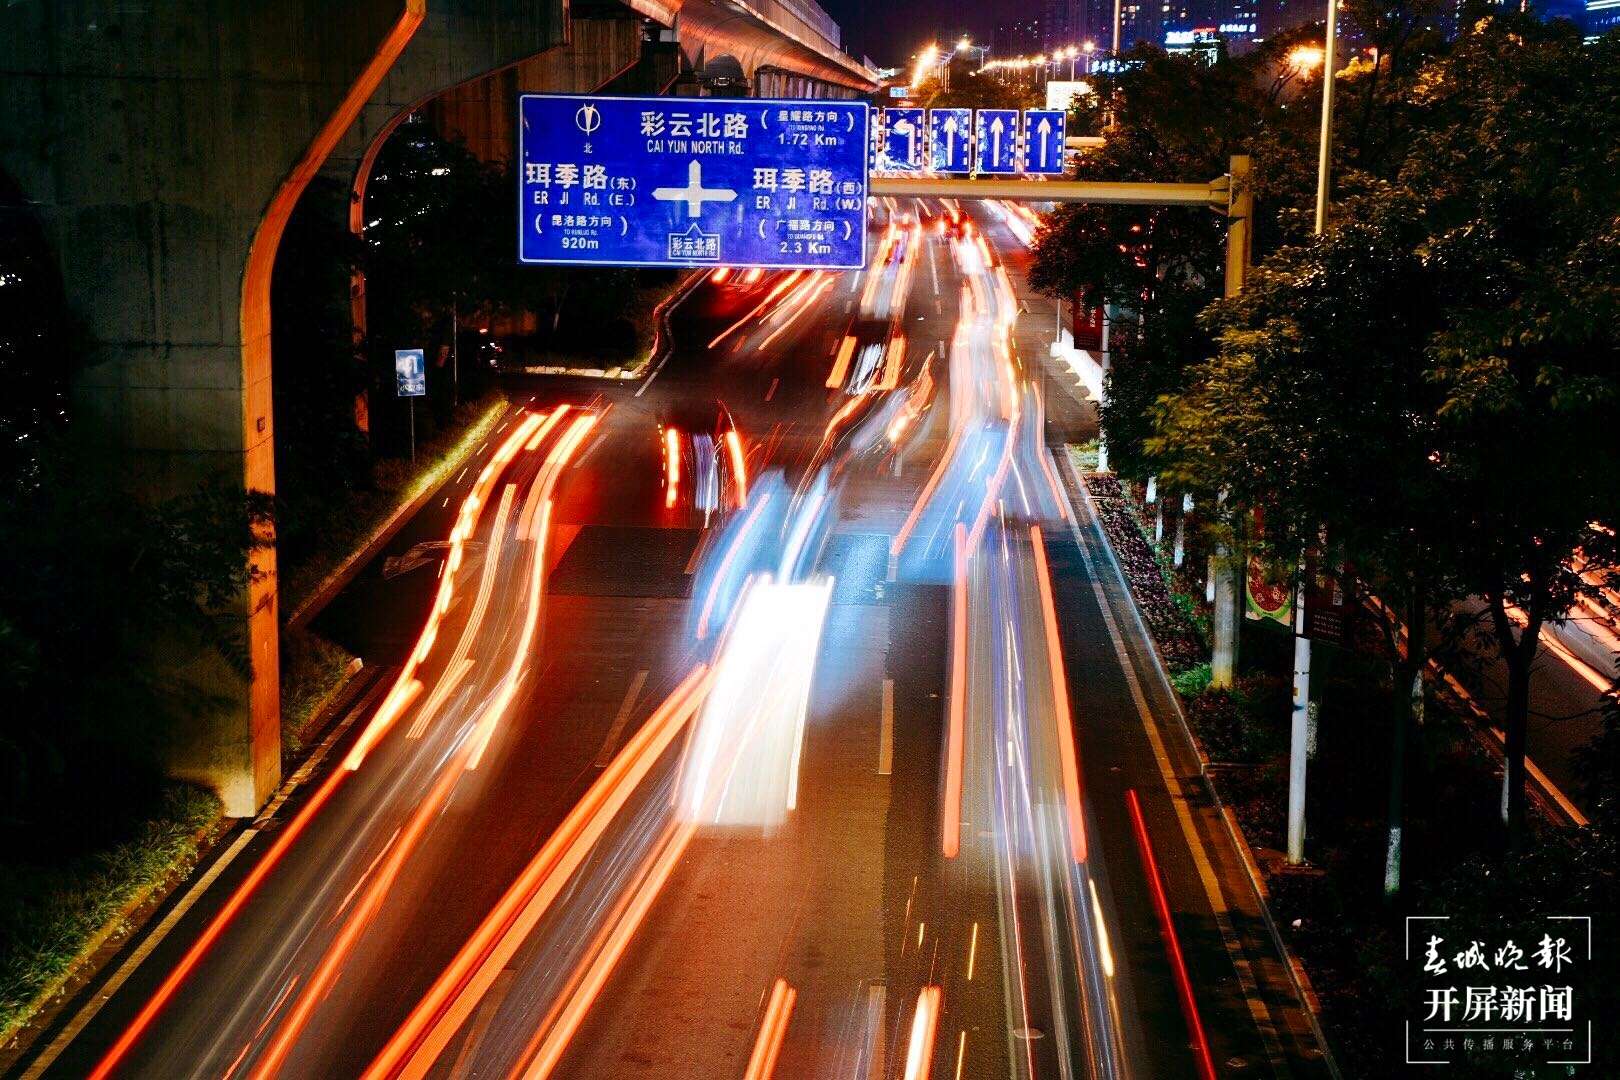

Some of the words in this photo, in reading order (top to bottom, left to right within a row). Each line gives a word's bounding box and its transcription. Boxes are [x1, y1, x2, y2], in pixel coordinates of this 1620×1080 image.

[640, 111, 748, 139] 彩云北路
[779, 133, 808, 145] 1.72
[815, 134, 837, 146] Km
[583, 142, 593, 154] 北
[647, 139, 663, 153] CAI
[668, 140, 687, 154] YUN
[691, 141, 724, 154] NORTH
[729, 141, 744, 155] Rd.
[534, 191, 548, 204] ER
[560, 192, 569, 204] JI
[584, 192, 600, 205] Rd.
[756, 196, 770, 209] ER
[786, 197, 796, 210] JI
[813, 197, 829, 210] Rd.
[562, 237, 599, 249] 920m
[672, 237, 716, 250] 彩云北路
[780, 241, 803, 253] 2.3
[808, 242, 831, 254] Km
